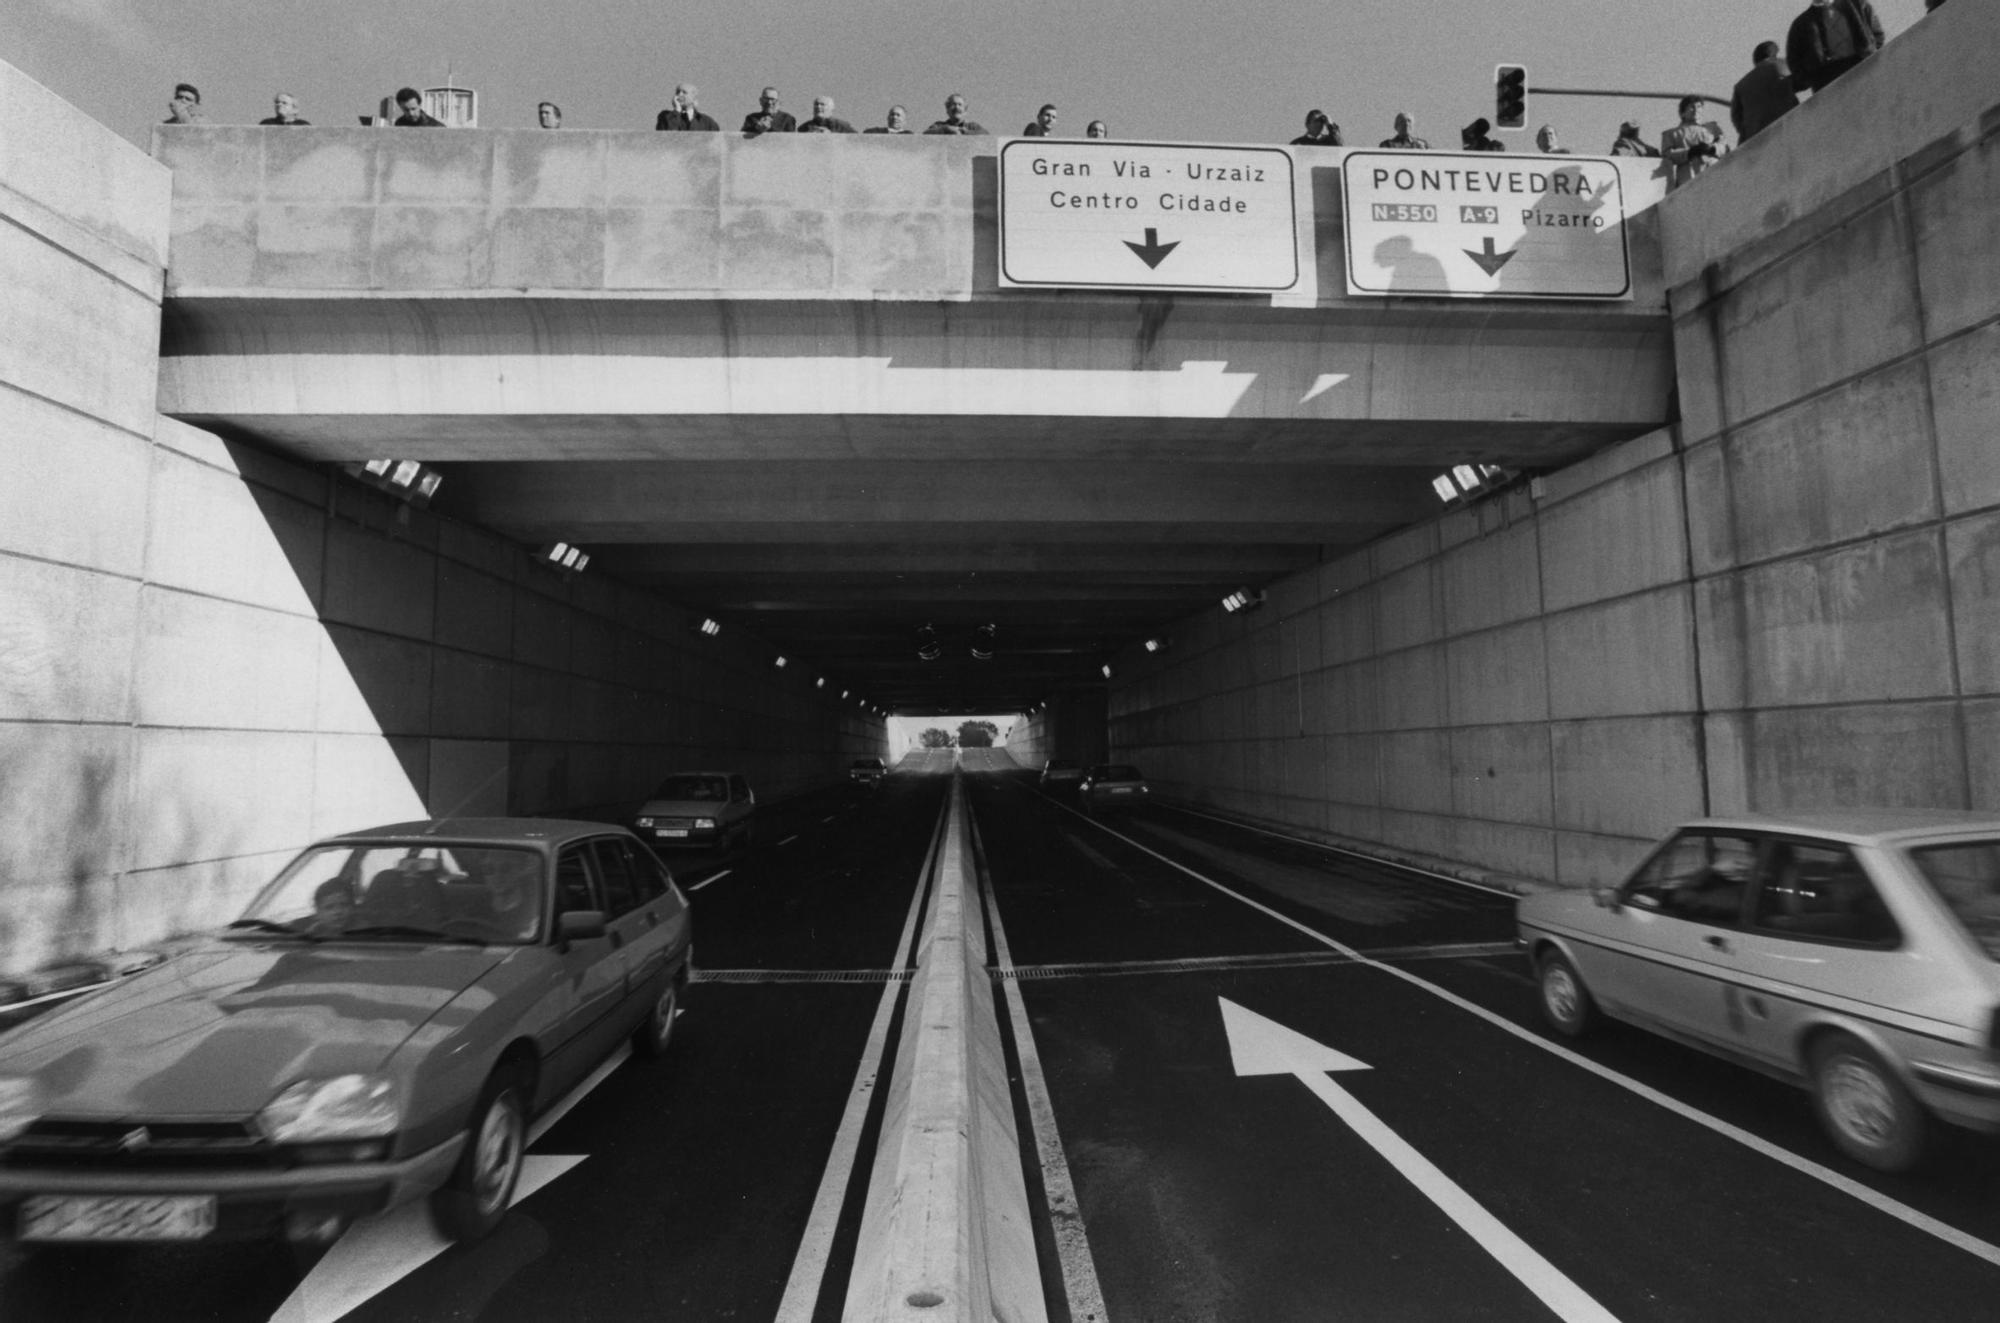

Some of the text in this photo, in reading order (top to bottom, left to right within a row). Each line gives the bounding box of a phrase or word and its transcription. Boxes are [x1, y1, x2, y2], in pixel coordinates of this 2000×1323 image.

[1032, 158, 1091, 177] Gran
[1113, 160, 1151, 178] Via
[1187, 163, 1265, 182] Urzaiz
[1373, 168, 1593, 195] PONTEVEDRA
[1050, 190, 1247, 213] Centro Cidade
[1521, 209, 1605, 228] Pizarro
